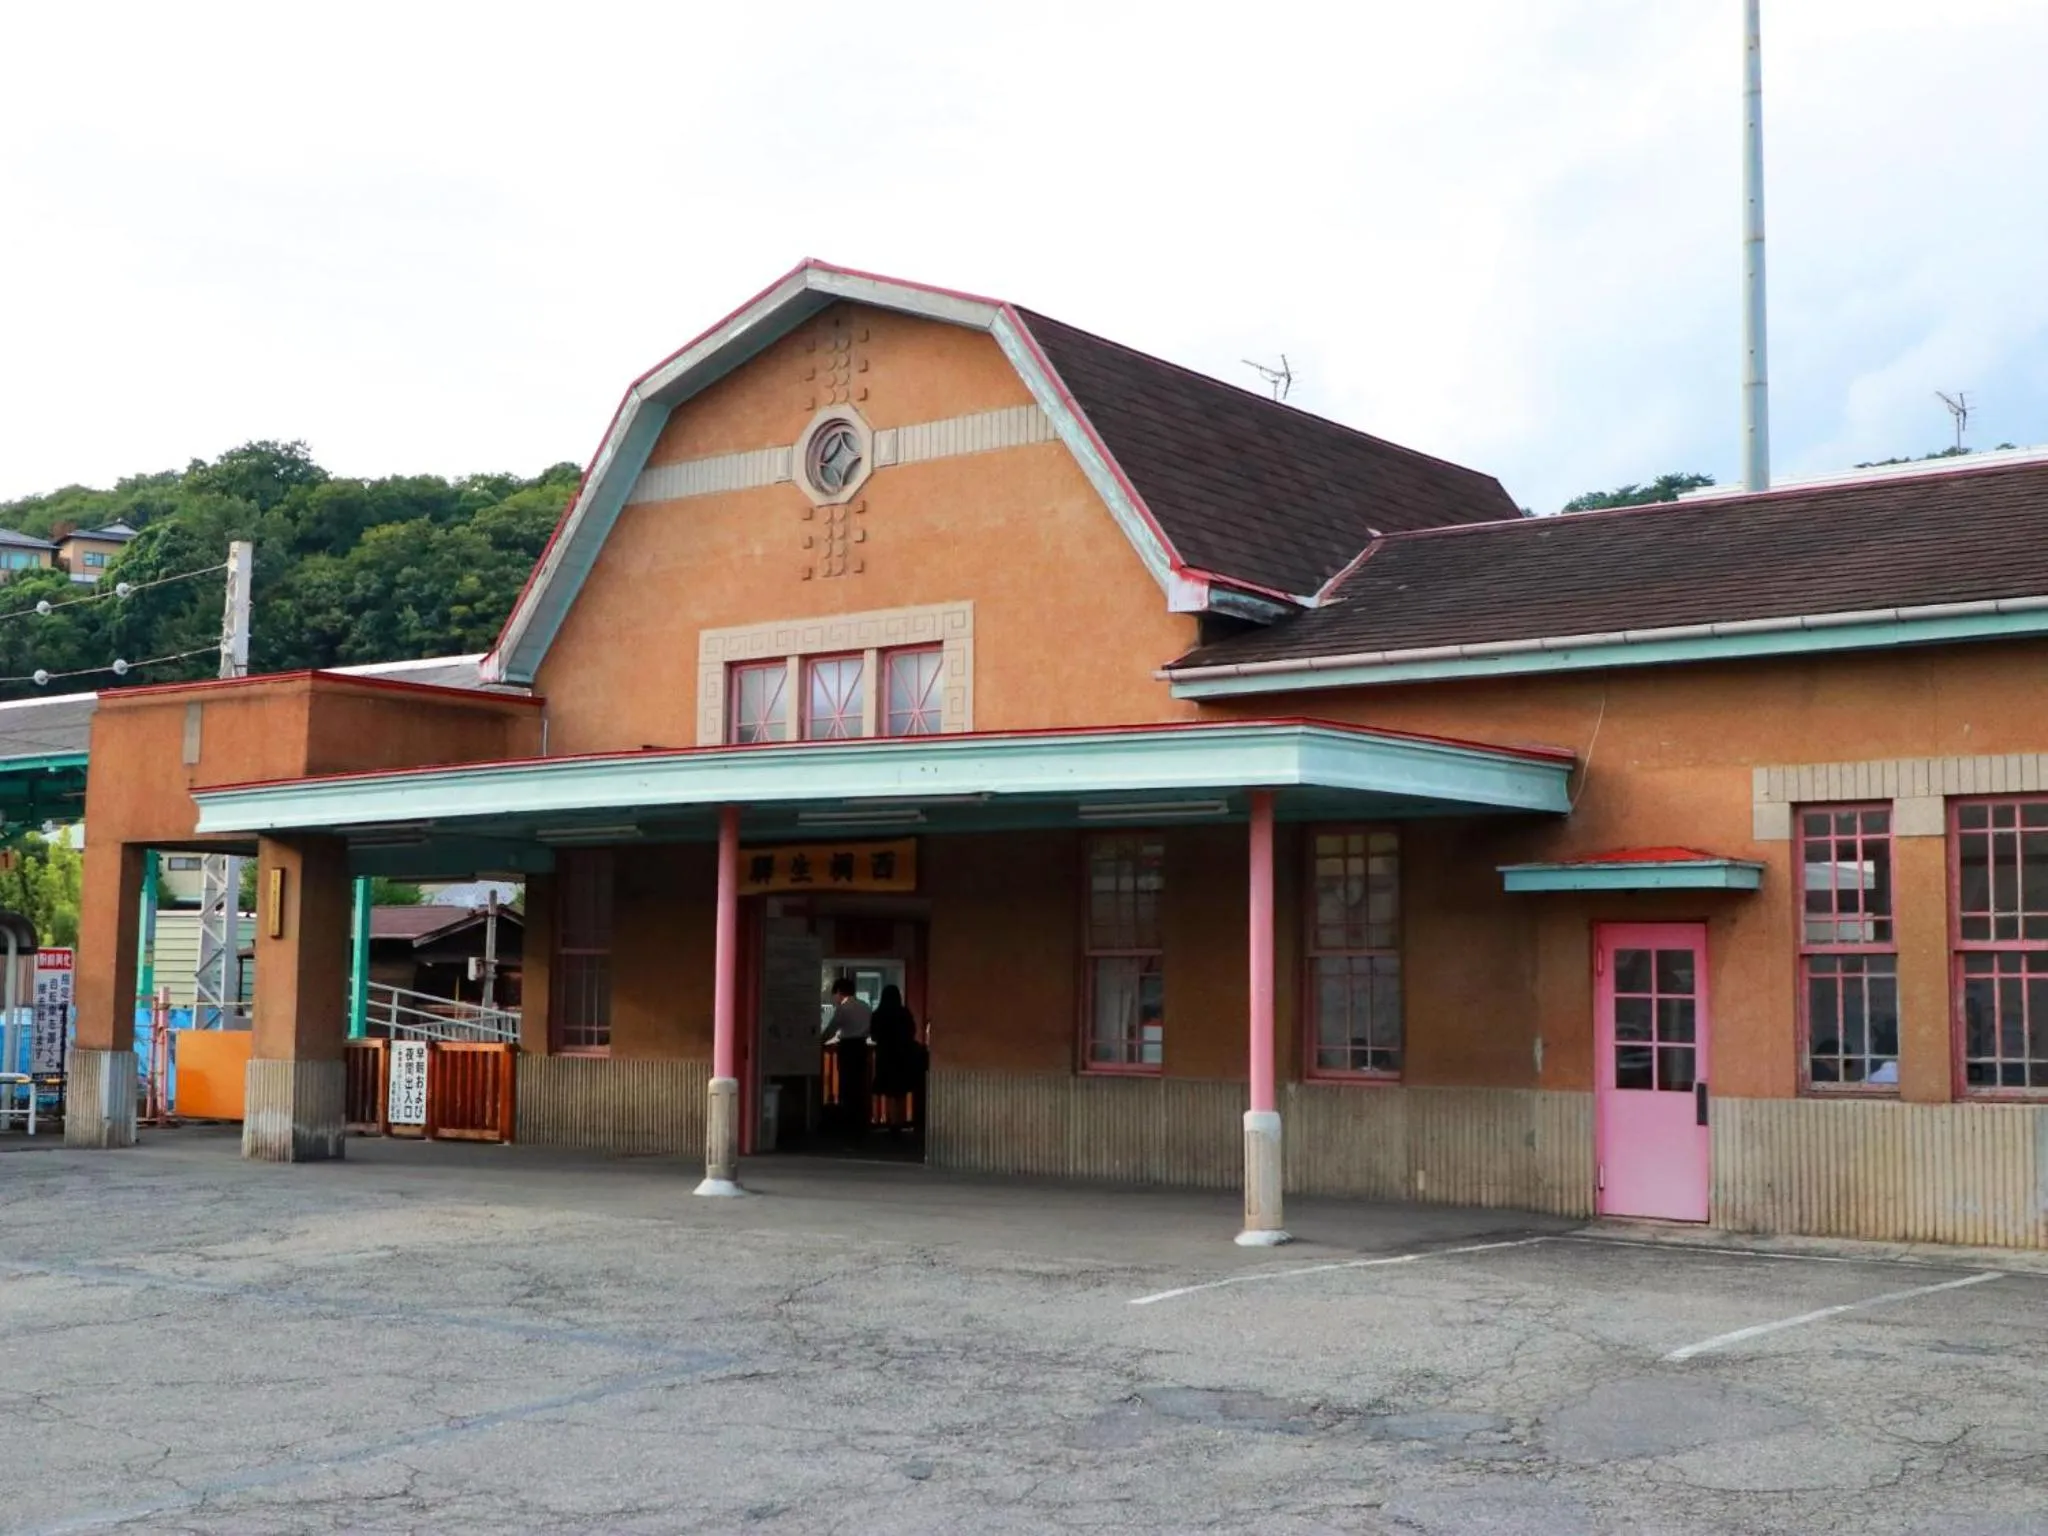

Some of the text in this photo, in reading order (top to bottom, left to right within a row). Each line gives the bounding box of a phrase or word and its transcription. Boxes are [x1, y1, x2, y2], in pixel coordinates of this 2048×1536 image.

[404, 1047, 414, 1118] 夜間出入口
